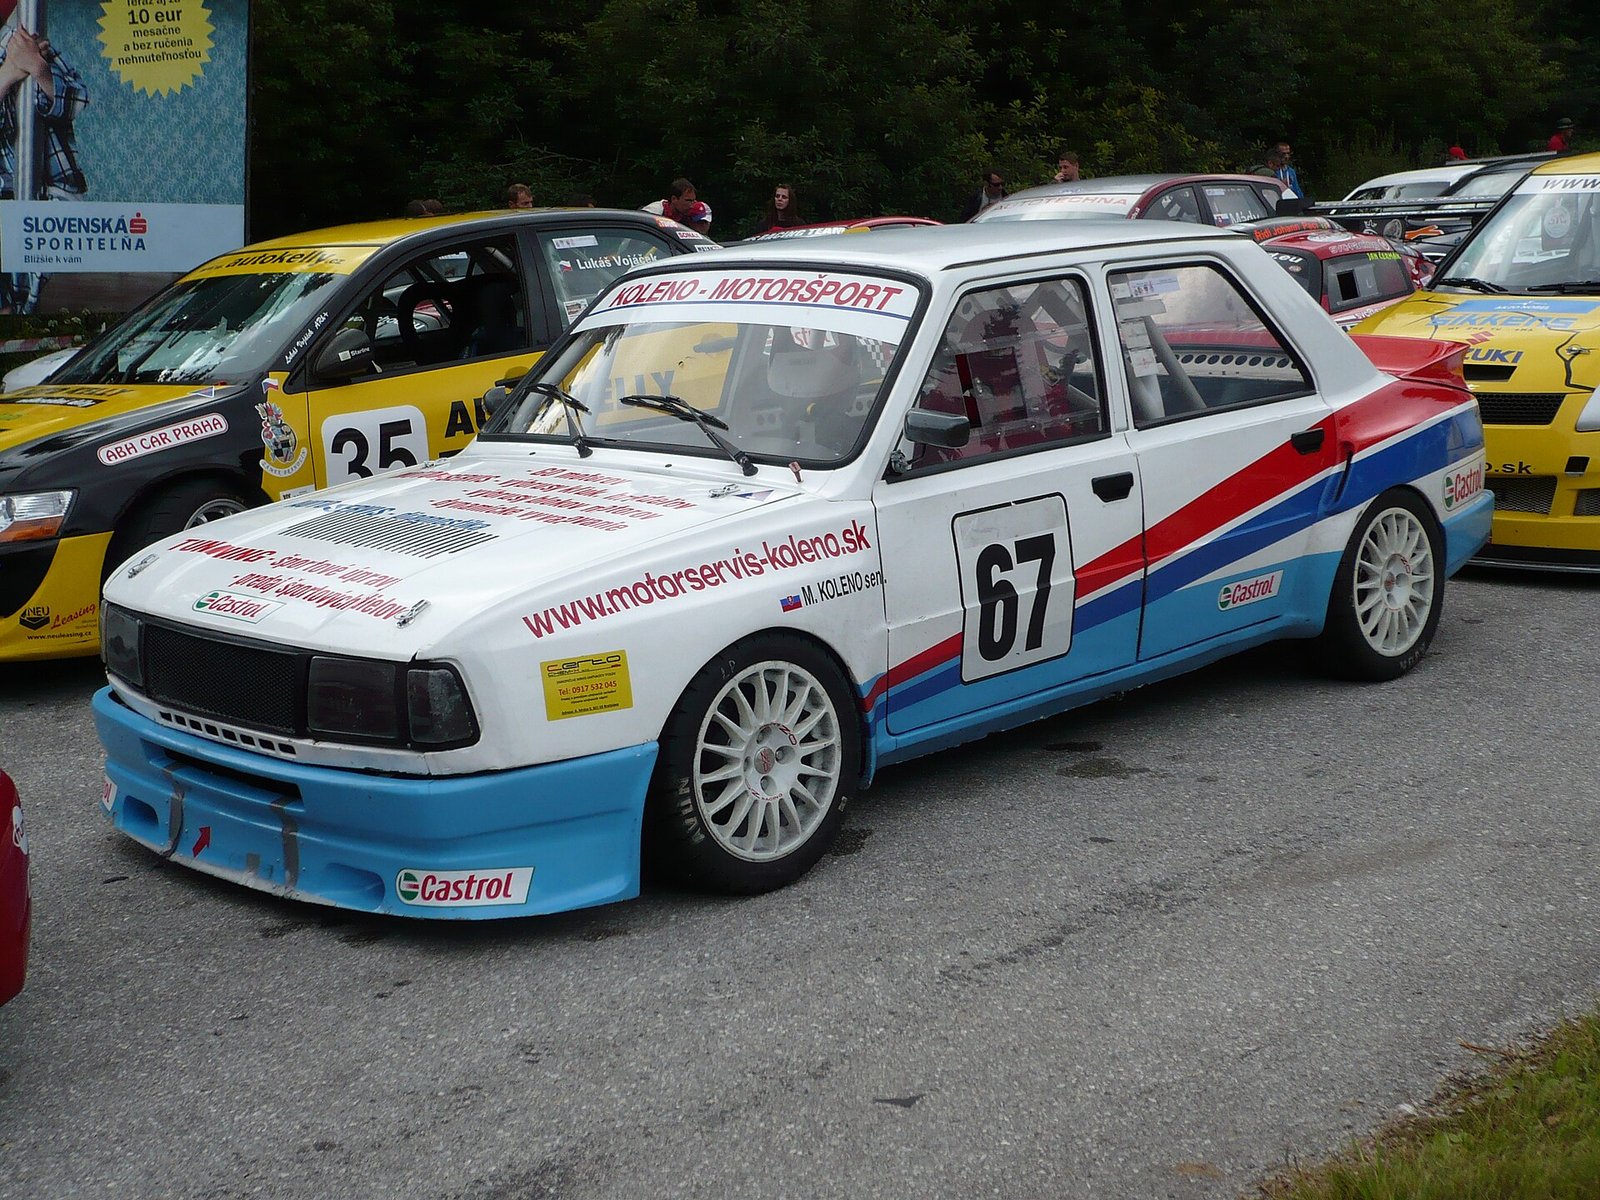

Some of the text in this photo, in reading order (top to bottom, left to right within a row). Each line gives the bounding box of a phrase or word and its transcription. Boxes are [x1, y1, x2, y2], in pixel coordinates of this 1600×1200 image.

[128, 9, 182, 25] 10 eur
[133, 26, 181, 37] mesačne
[133, 41, 152, 51] bez
[154, 37, 193, 49] ručenia
[118, 48, 201, 65] nehnuteľnosťou
[23, 215, 128, 233] SLOVENSKÁ
[24, 236, 146, 250] SPORITEĽŇA
[55, 255, 61, 264] k
[63, 255, 82, 264] vám
[577, 252, 657, 270] Lukáš Vojáček
[609, 279, 699, 307] KOLENO
[708, 273, 903, 310] MOTORŠPORT
[106, 418, 223, 462] ABH CAR PRAHA
[331, 419, 419, 478] 35
[1455, 463, 1483, 503] Castrol
[228, 573, 294, 594] predaj
[522, 519, 871, 638] www.motorservis-koleno.sk
[801, 570, 887, 606] M. KOLENO sen.
[976, 533, 1056, 662] 67
[1232, 575, 1275, 604] Castrol
[27, 606, 50, 617] NEU
[209, 595, 271, 617] Castrol
[51, 604, 97, 630] Leasing
[27, 631, 91, 640] www.neuleasing.cz
[558, 680, 617, 696] Tel: 0917 532 045
[421, 872, 514, 901] Castrol
